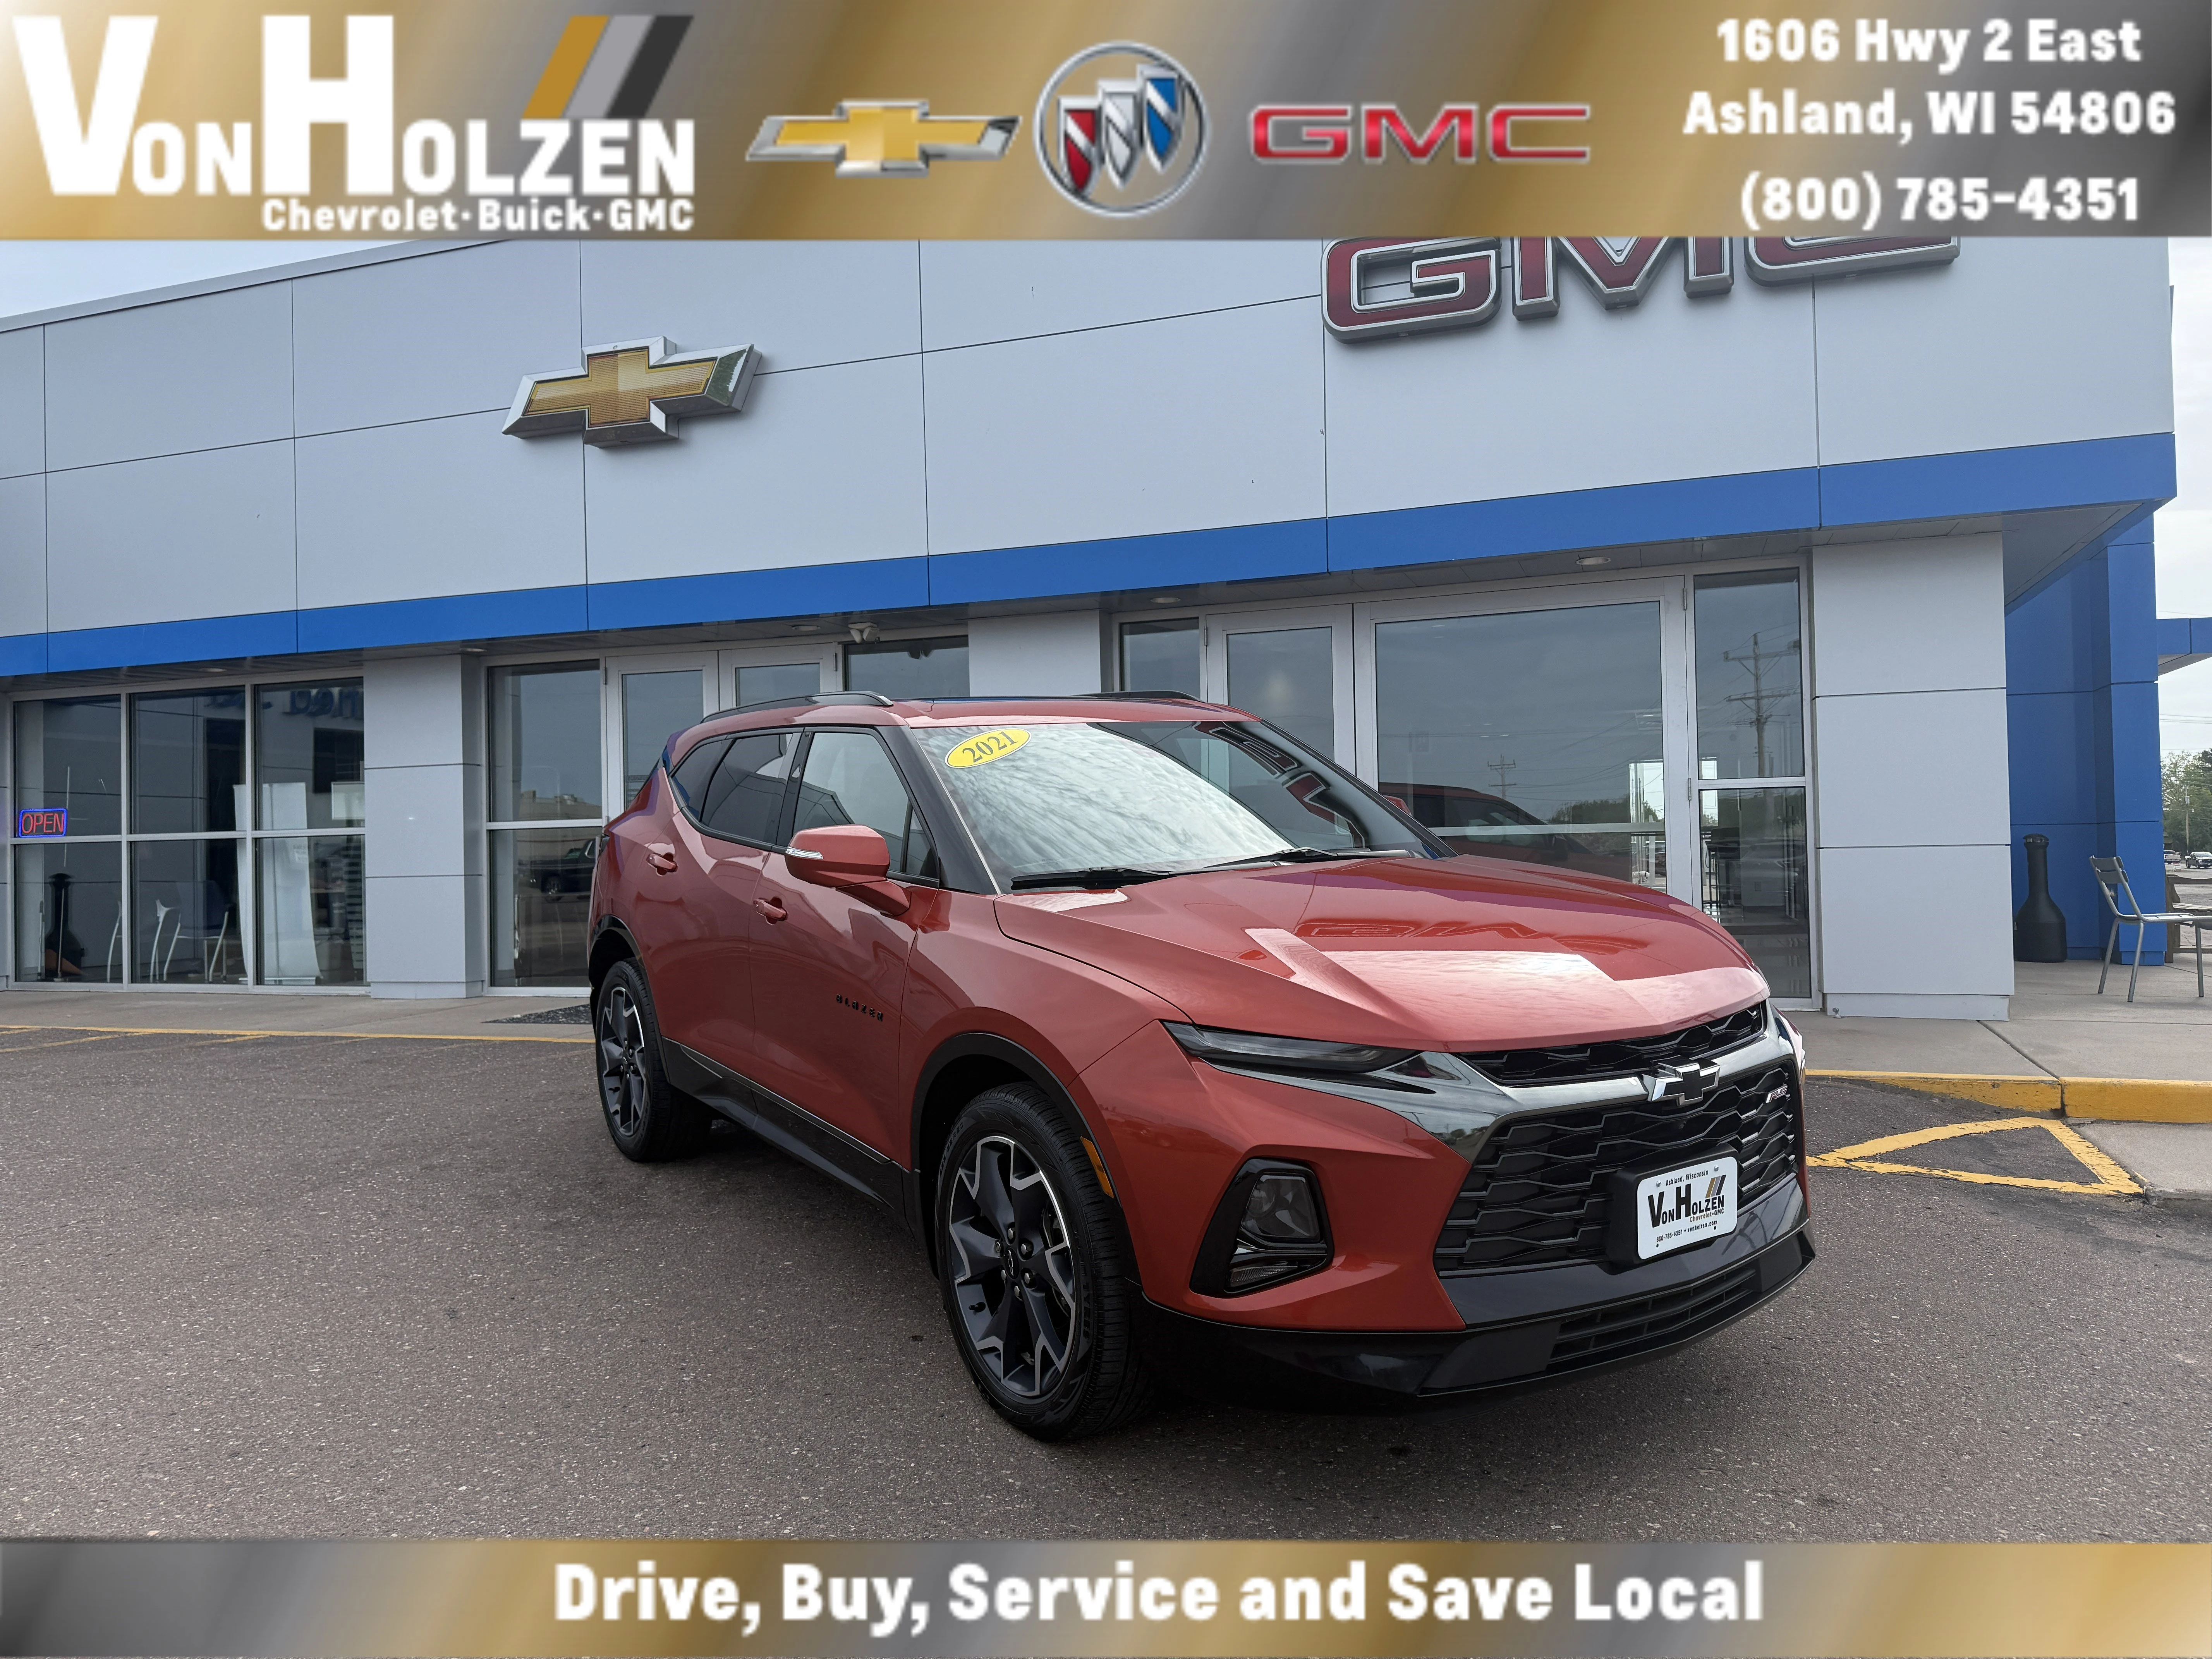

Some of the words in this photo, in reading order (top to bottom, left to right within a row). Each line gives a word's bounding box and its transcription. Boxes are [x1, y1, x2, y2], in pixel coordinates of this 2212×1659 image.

[962, 731, 1018, 763] 2021
[22, 813, 64, 834] OPEN
[836, 994, 883, 1022] BLAZER
[1766, 1085, 1788, 1103] RS
[1666, 1175, 1684, 1186] Ashland,
[1686, 1170, 1708, 1180] Wisconsin
